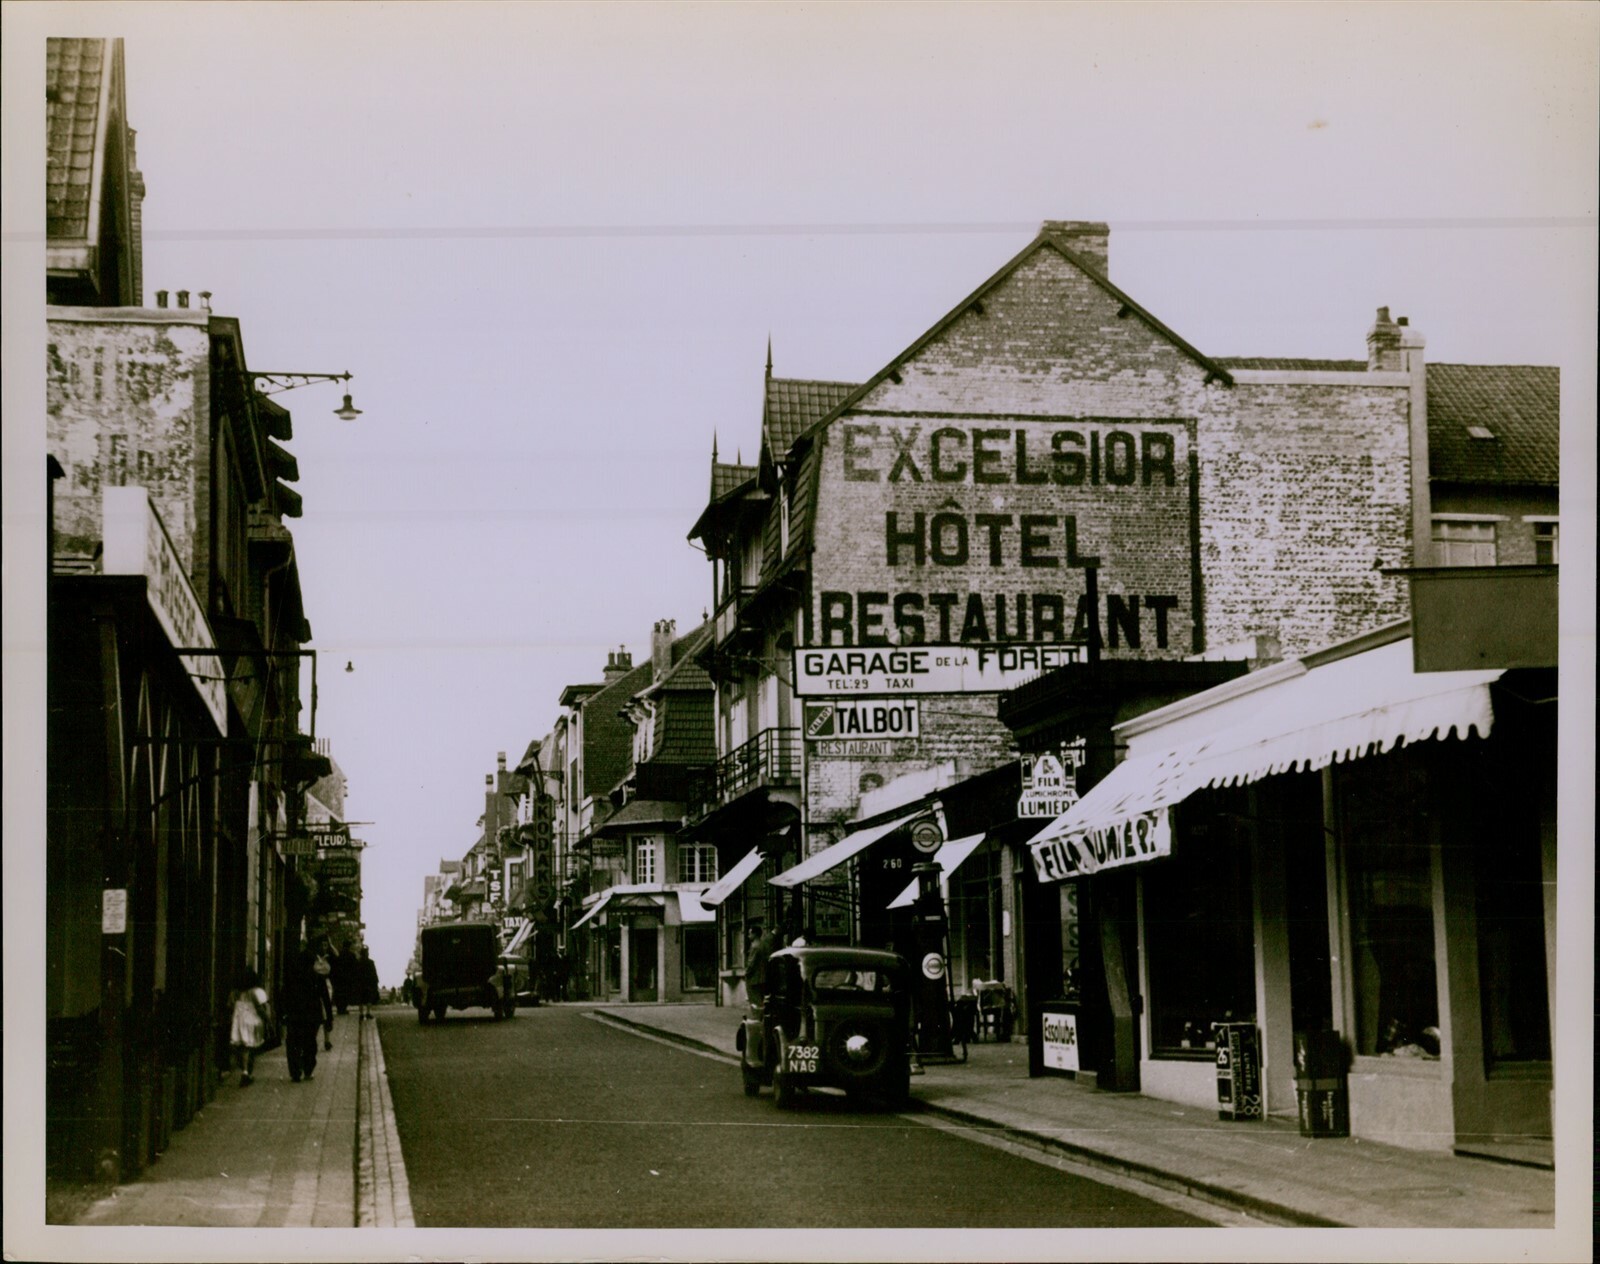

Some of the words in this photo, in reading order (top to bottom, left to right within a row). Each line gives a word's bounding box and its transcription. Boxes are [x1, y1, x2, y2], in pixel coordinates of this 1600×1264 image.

[843, 424, 1175, 487] EXCELSIOR
[886, 500, 1100, 568] HÔTEL
[820, 591, 1179, 649] RESTAURANT
[804, 651, 930, 676] GARAGE
[935, 657, 950, 667] DE
[954, 656, 969, 666] LA
[886, 677, 914, 689] TAXI
[835, 706, 915, 734] TALBOT
[820, 741, 889, 755] RESTAURANT
[1038, 777, 1060, 787] FILM
[1025, 790, 1073, 798] LUMICHROME
[1020, 799, 1078, 816] LUMIÈR
[313, 834, 347, 847] FLEURS
[537, 804, 550, 900] KODAKS
[489, 869, 502, 904] TSF
[788, 1045, 820, 1060] 7382
[789, 1060, 817, 1073] NAG
